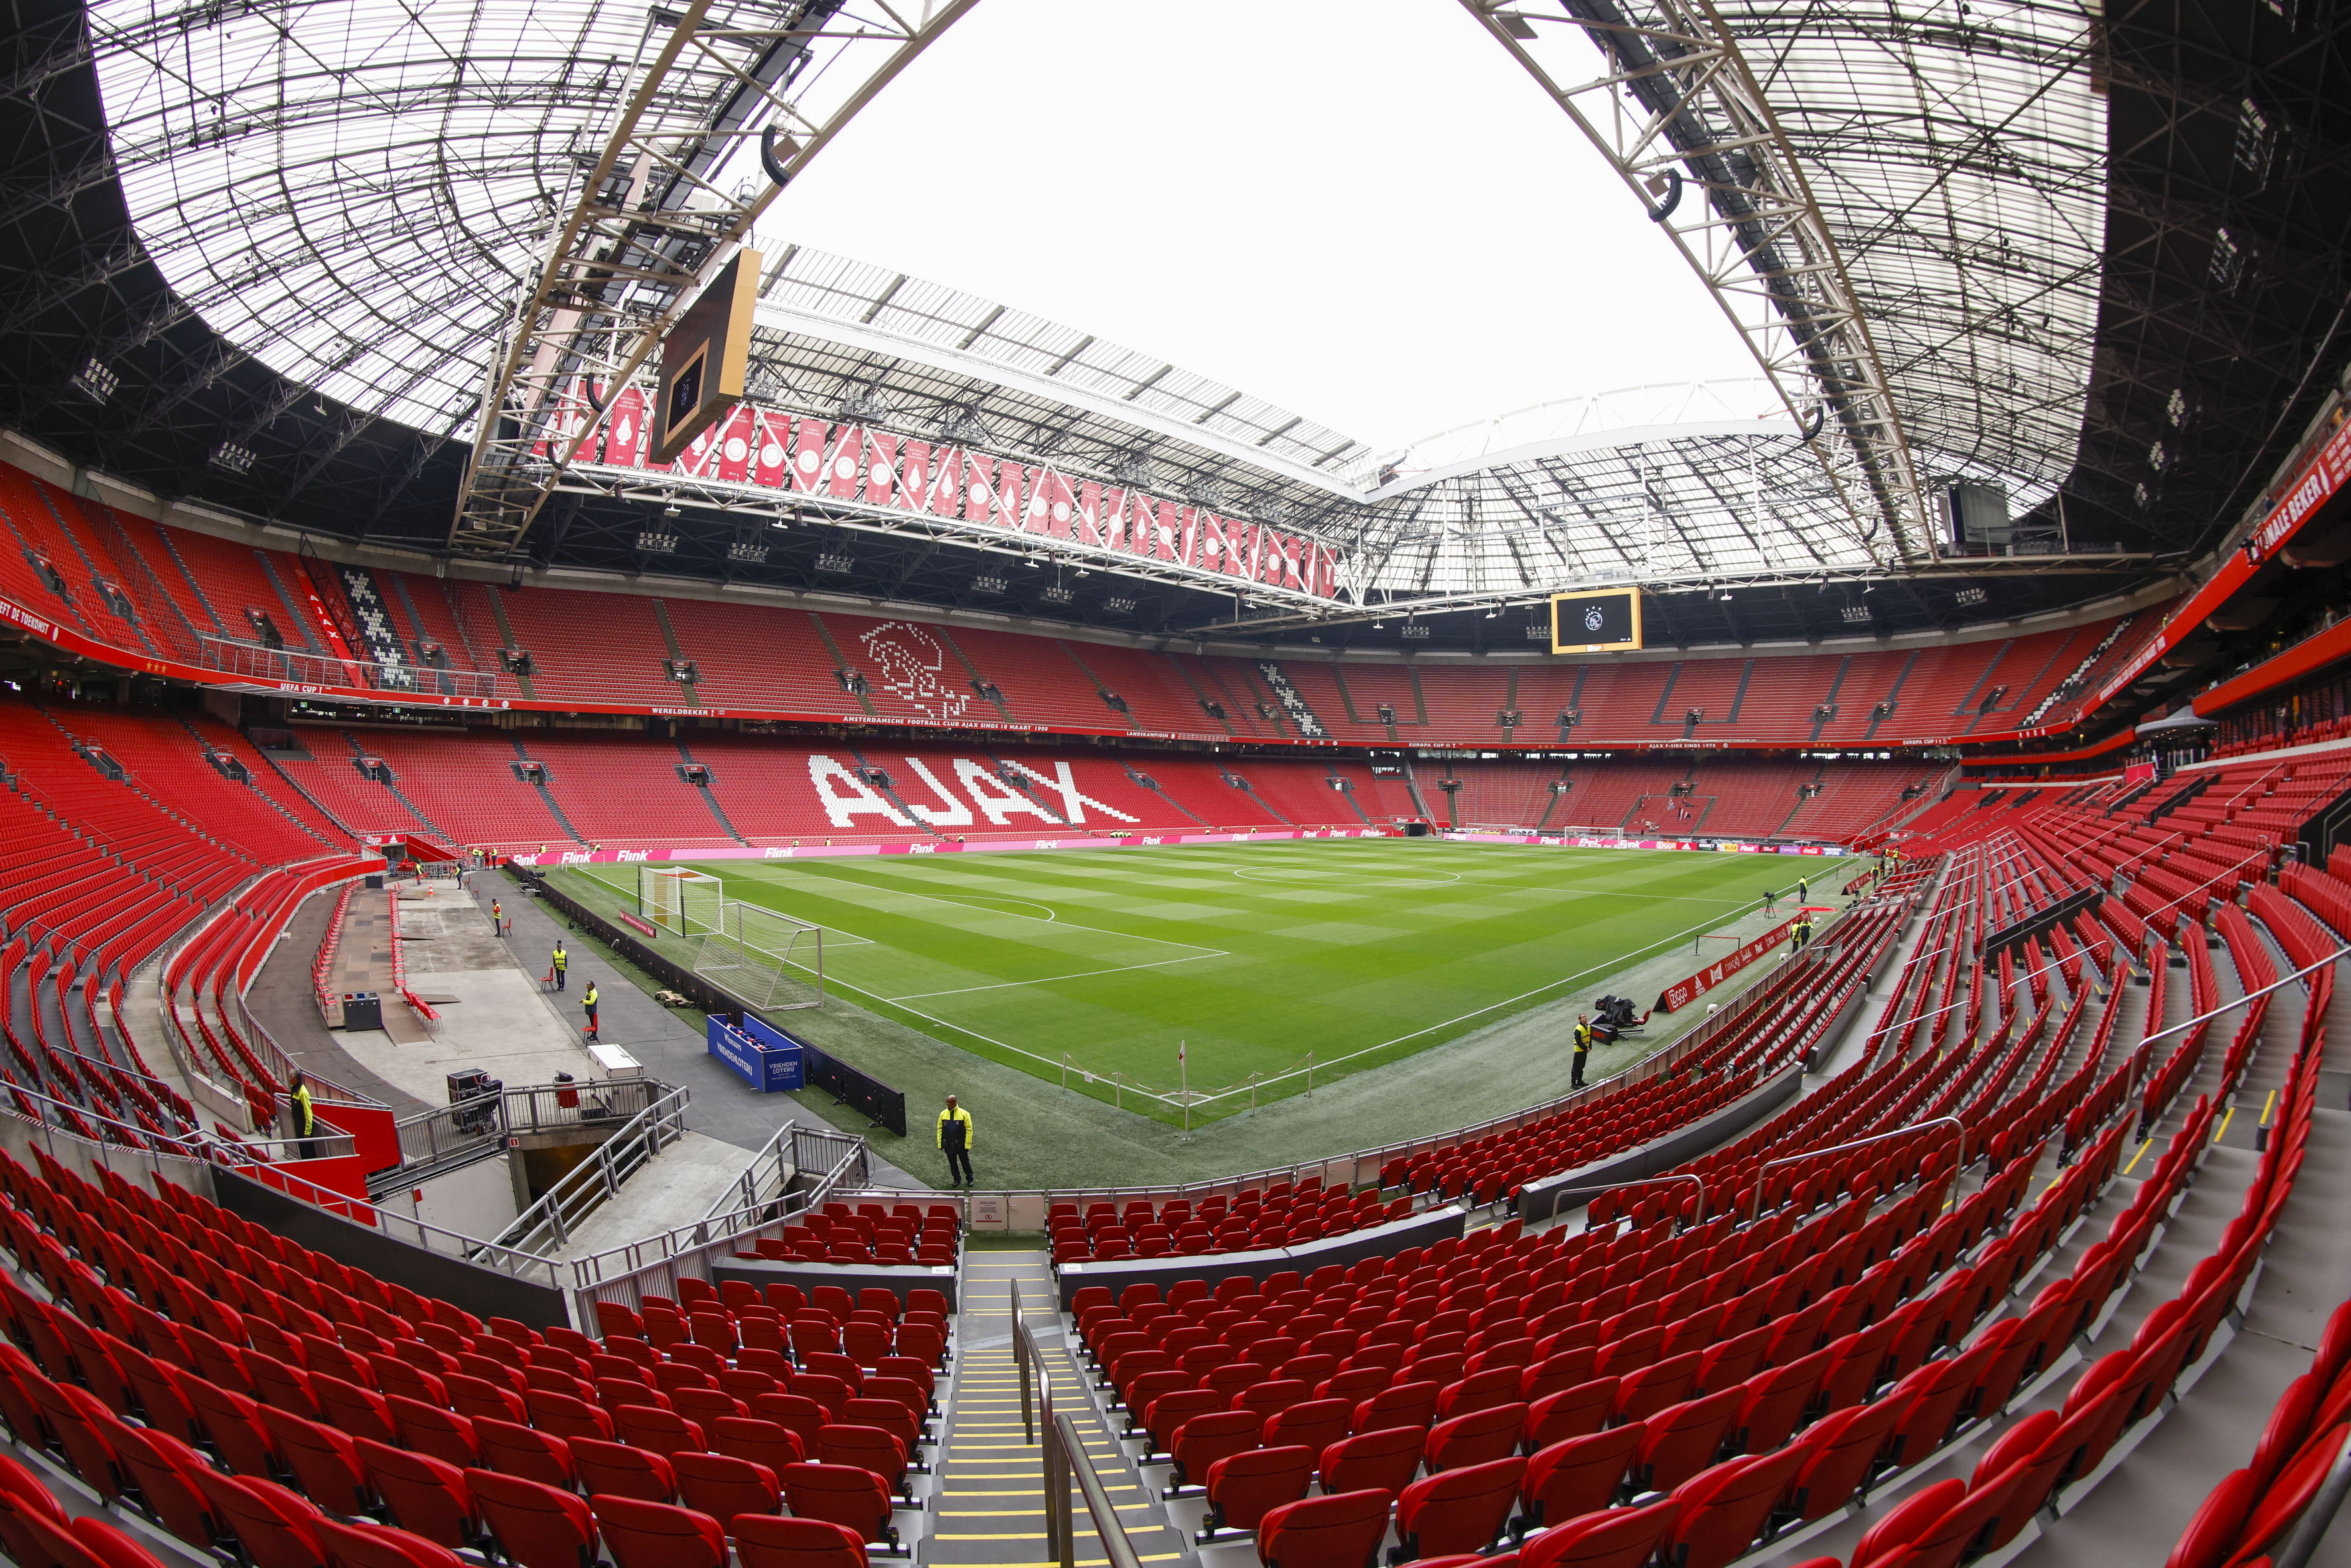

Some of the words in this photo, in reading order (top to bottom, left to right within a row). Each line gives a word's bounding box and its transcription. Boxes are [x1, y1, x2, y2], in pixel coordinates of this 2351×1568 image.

[2288, 474, 2322, 523] BEKER
[11, 607, 21, 621] DE
[21, 612, 49, 634] TOEKOMST
[280, 683, 299, 691] UEFA
[808, 754, 1140, 828] AJAX
[1035, 839, 1060, 849] Flink
[1141, 836, 1164, 845] Flink
[1540, 837, 1565, 845] Flink
[616, 849, 653, 861] Flink
[764, 847, 796, 858] Flink
[909, 844, 940, 854] Flink
[513, 853, 541, 866] Flink
[561, 851, 596, 864] Flink
[1695, 987, 1706, 997] adidas
[724, 1032, 742, 1051] Winnaars
[717, 1042, 752, 1076] VRIENDENLOTERIJ
